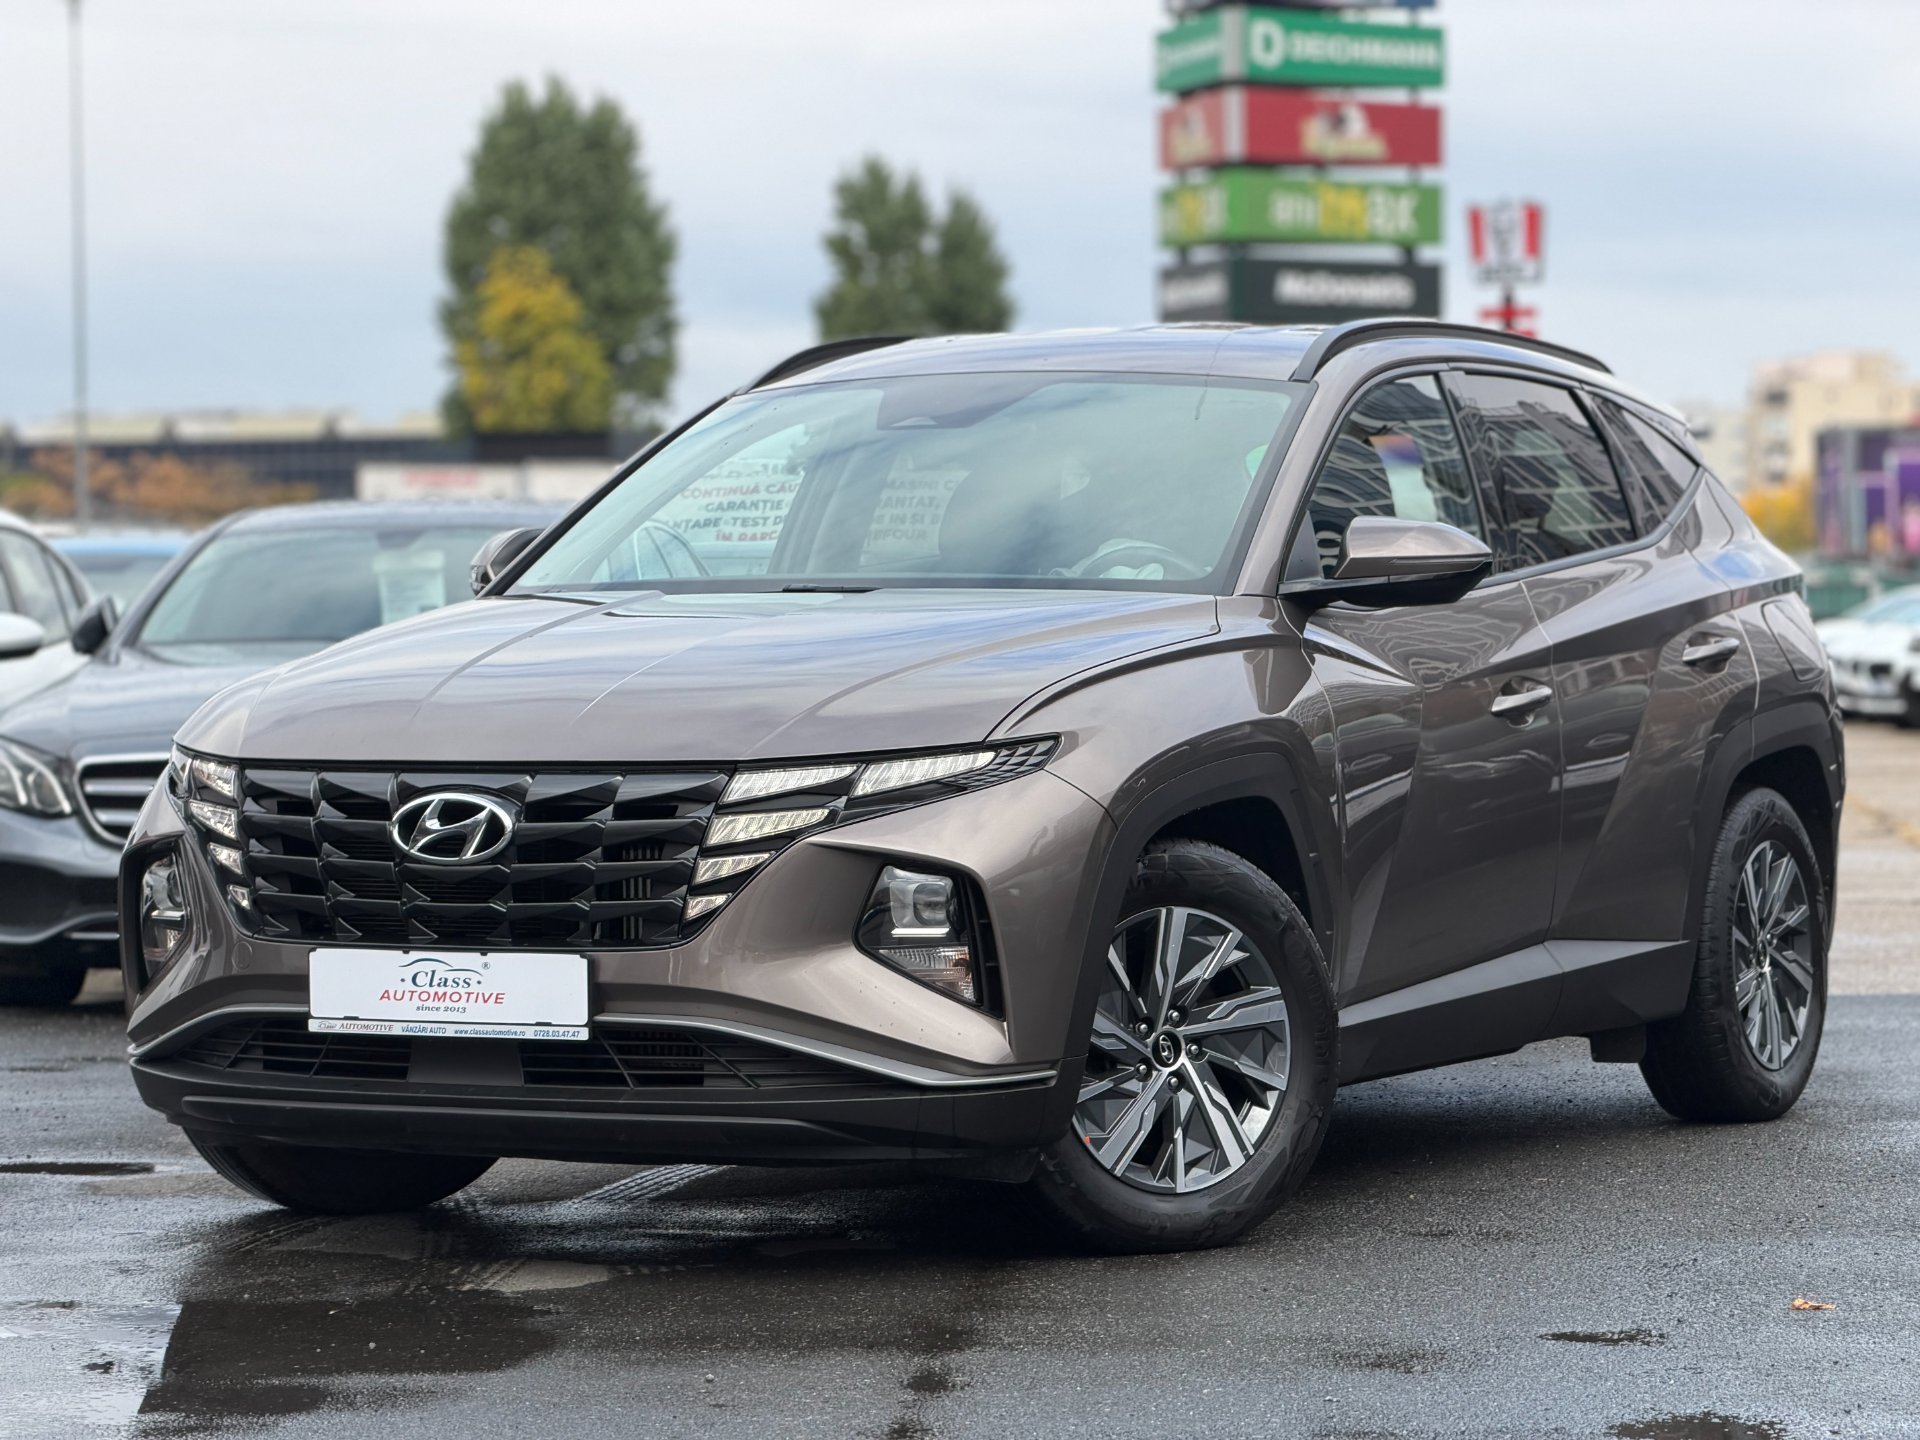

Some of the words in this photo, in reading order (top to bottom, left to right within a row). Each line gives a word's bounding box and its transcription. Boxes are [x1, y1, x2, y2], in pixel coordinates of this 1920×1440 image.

[410, 969, 473, 989] Class
[379, 989, 506, 1005] AUTOMOTIVE
[415, 1004, 441, 1012] since
[442, 1005, 467, 1014] 2013
[338, 1022, 394, 1032] AUTOMOTIVE
[428, 1025, 447, 1034] AUTO
[454, 1027, 526, 1037] www.classautomotive.ro
[533, 1029, 580, 1038] 0728.03.47.47
